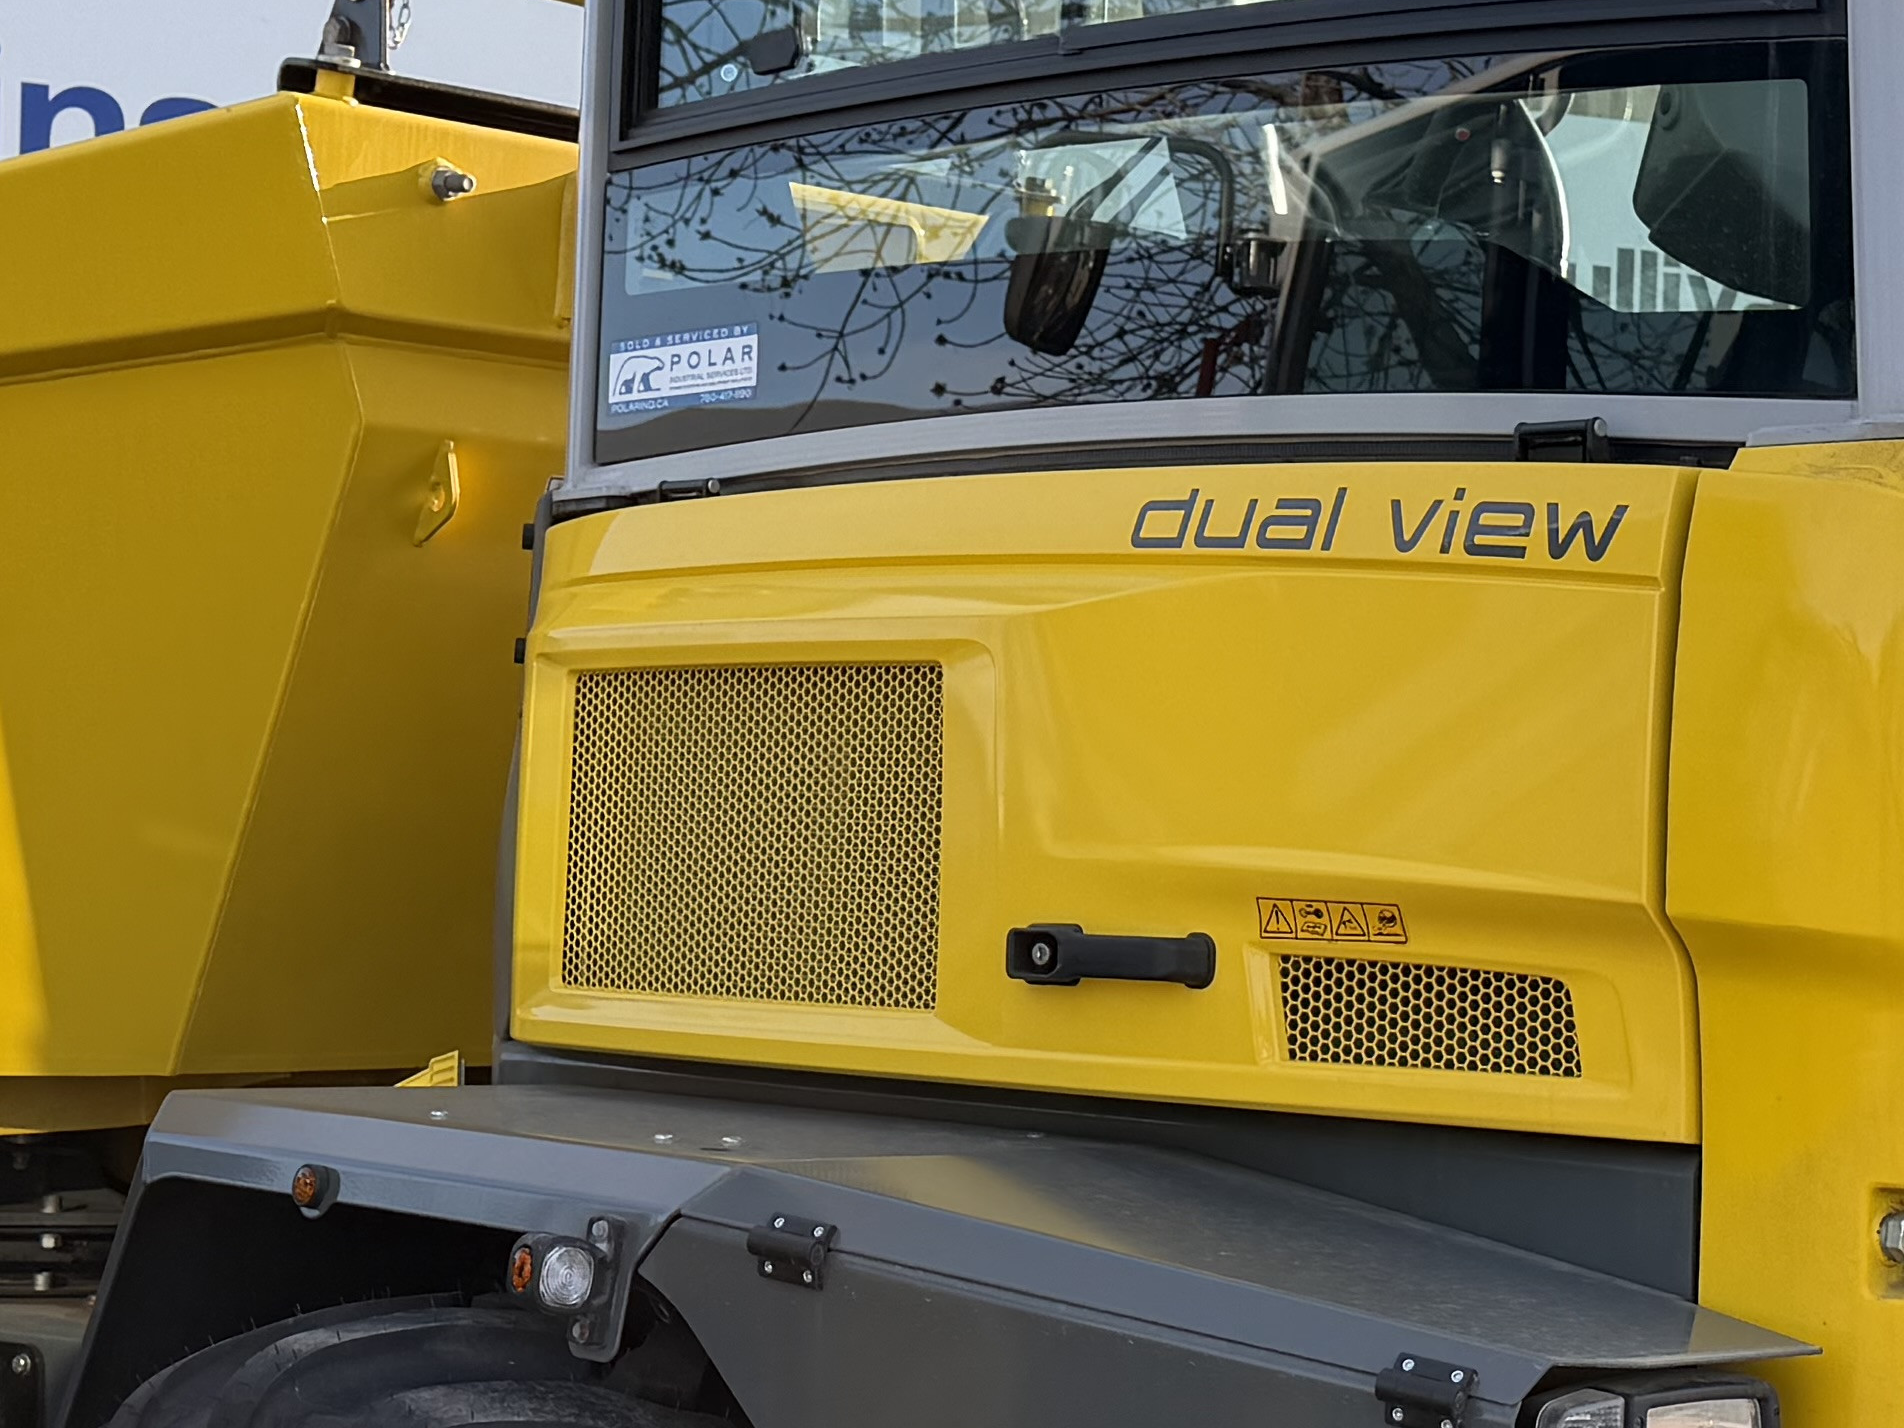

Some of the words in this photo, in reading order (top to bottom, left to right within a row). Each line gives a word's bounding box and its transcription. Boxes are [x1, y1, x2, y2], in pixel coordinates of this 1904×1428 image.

[669, 344, 754, 372] POLAR
[1130, 486, 1349, 552] dual
[1390, 486, 1630, 562] view
